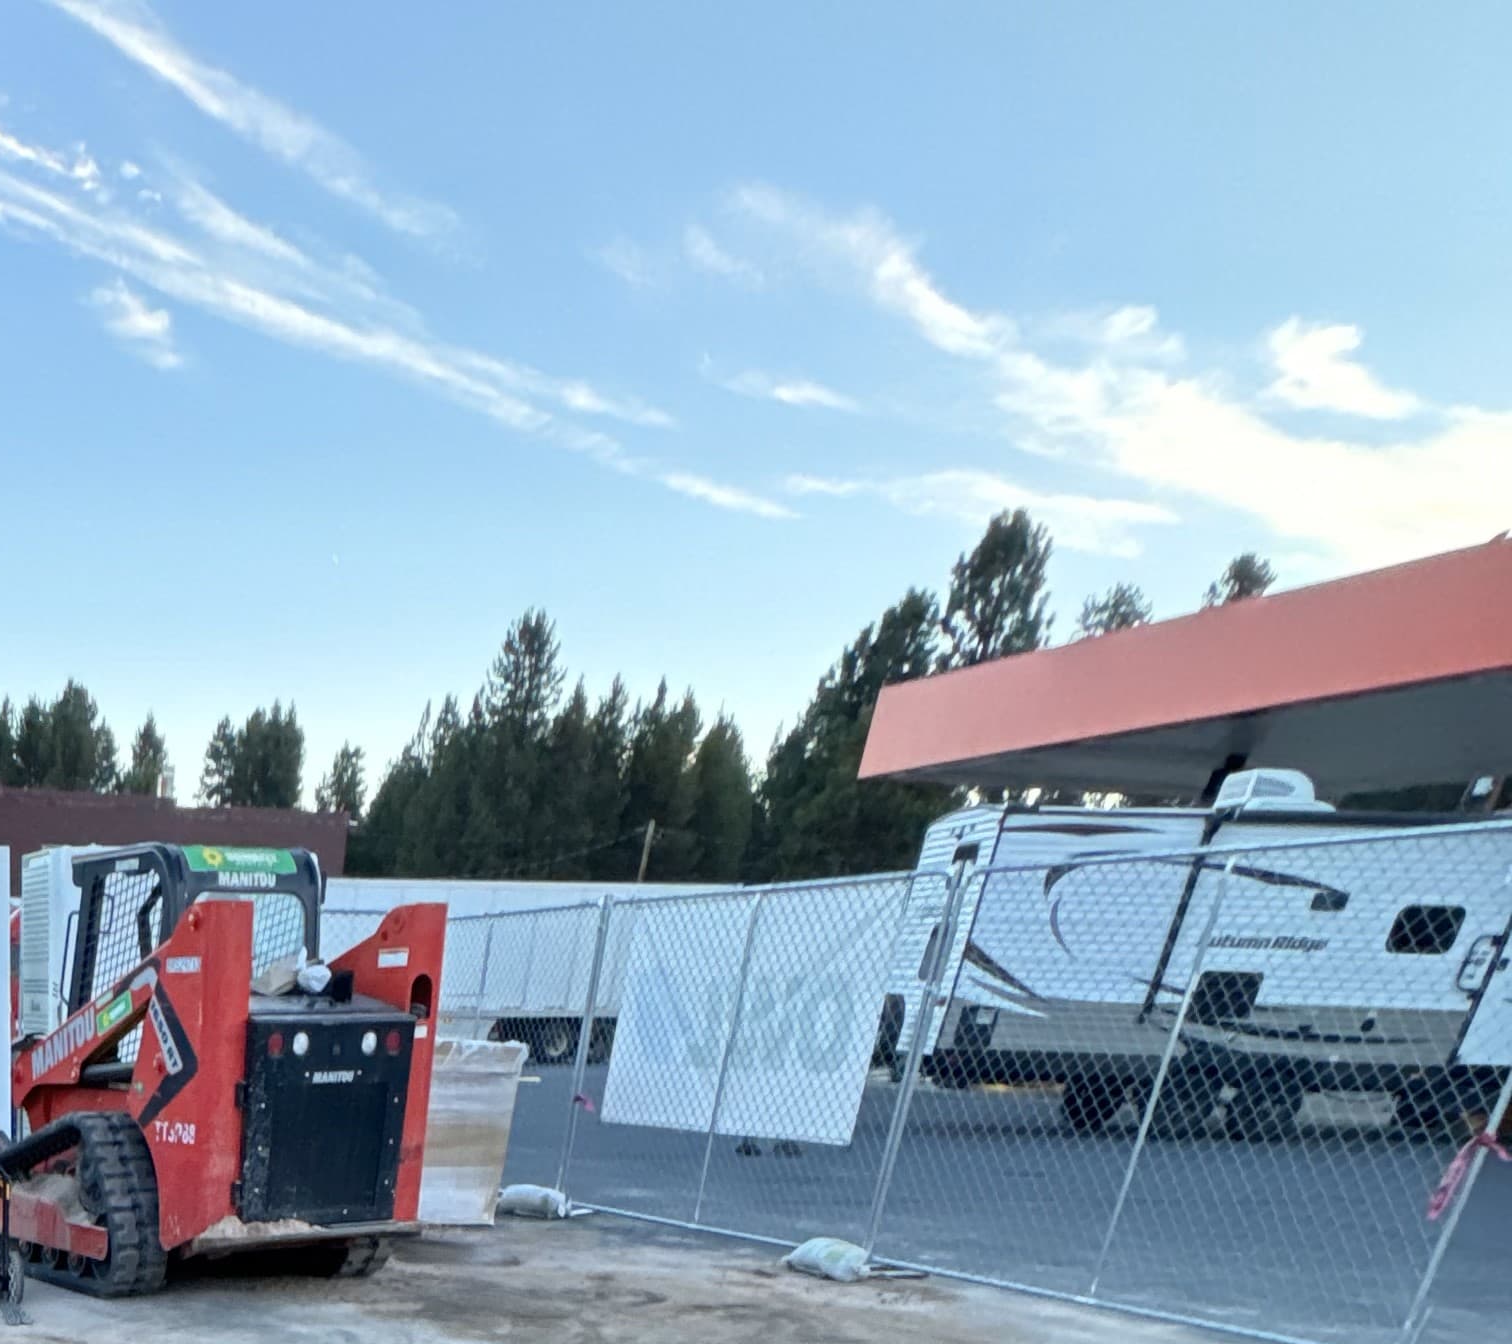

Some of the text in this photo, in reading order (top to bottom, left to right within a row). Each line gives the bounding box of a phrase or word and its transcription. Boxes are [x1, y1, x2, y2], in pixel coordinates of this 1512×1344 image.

[218, 871, 277, 888] MANITOU
[1198, 934, 1271, 950] utumn
[31, 1006, 95, 1081] MANITOU
[312, 1070, 355, 1085] MANITOU
